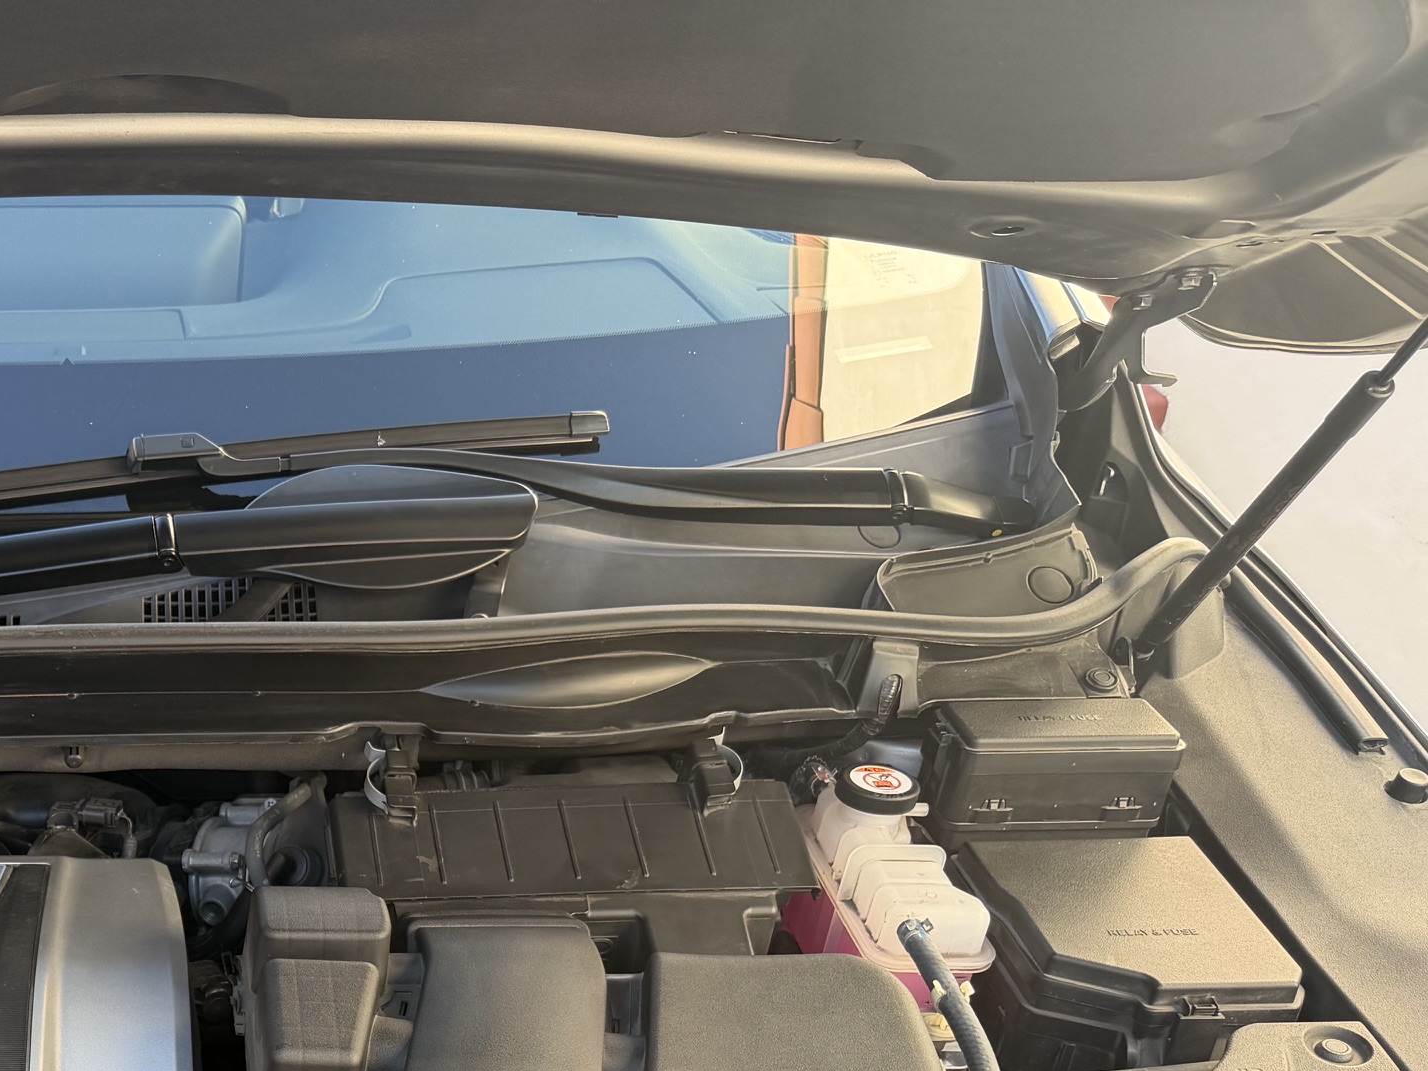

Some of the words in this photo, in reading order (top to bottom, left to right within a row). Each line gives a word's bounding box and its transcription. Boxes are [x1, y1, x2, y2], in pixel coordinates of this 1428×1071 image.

[1106, 928, 1148, 937] RELAY
[1151, 928, 1163, 936] &
[1163, 927, 1200, 936] FUSE
